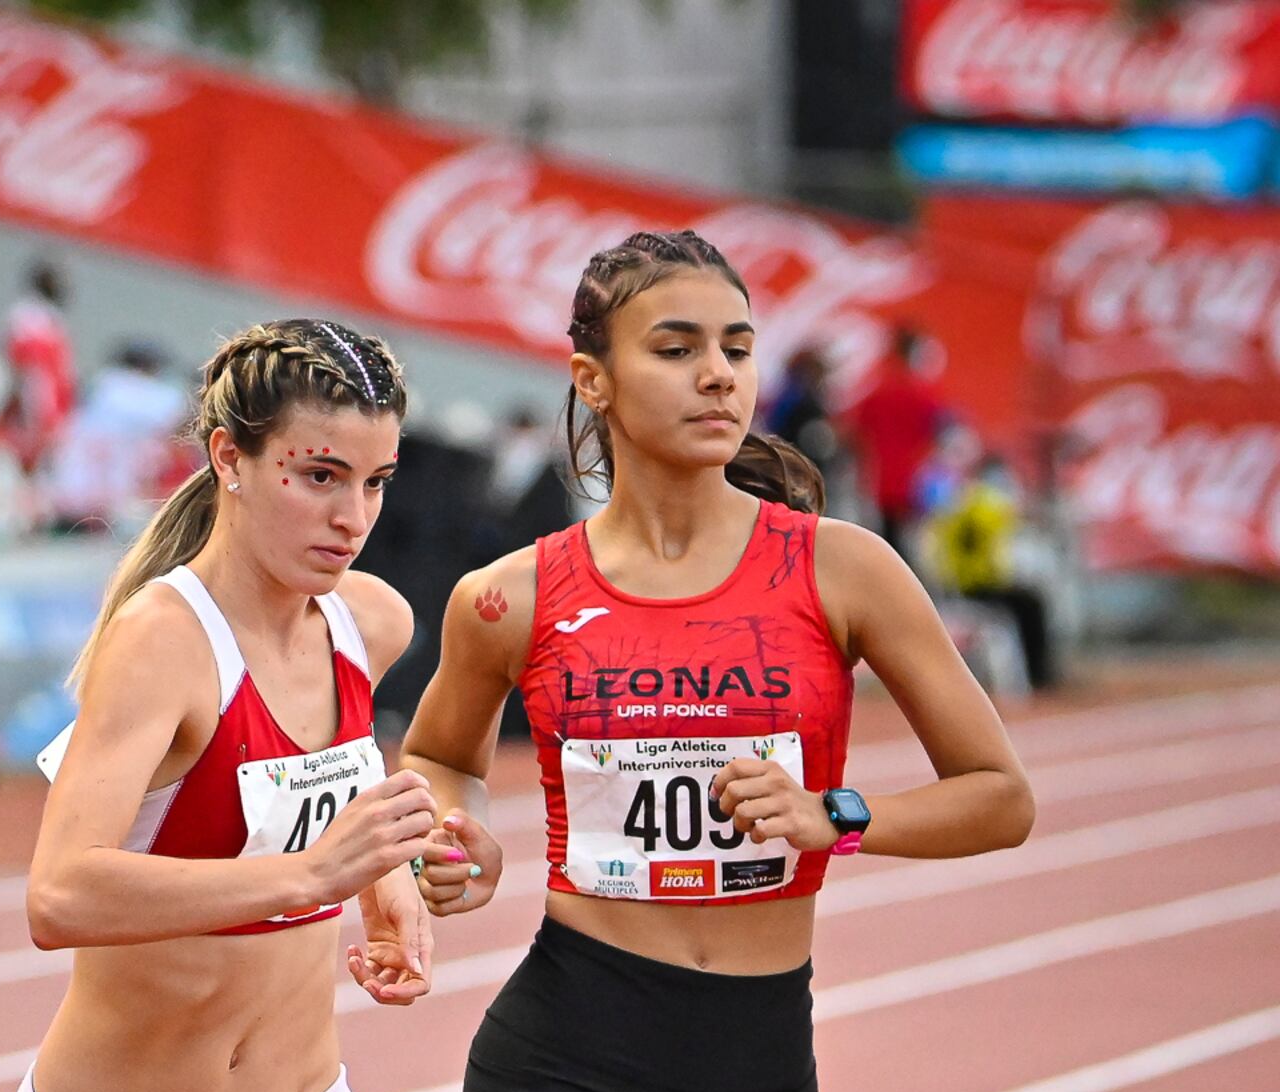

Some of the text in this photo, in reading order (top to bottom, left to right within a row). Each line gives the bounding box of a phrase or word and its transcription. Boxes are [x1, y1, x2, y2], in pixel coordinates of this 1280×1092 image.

[565, 666, 792, 701] LEONAS
[616, 704, 728, 718] UPR PONCE
[636, 740, 727, 757] Liga Atletica
[303, 757, 320, 772] Liga
[290, 763, 360, 791] Interuniversitaria
[598, 878, 636, 888] SEGUROS
[660, 875, 705, 888] HORA
